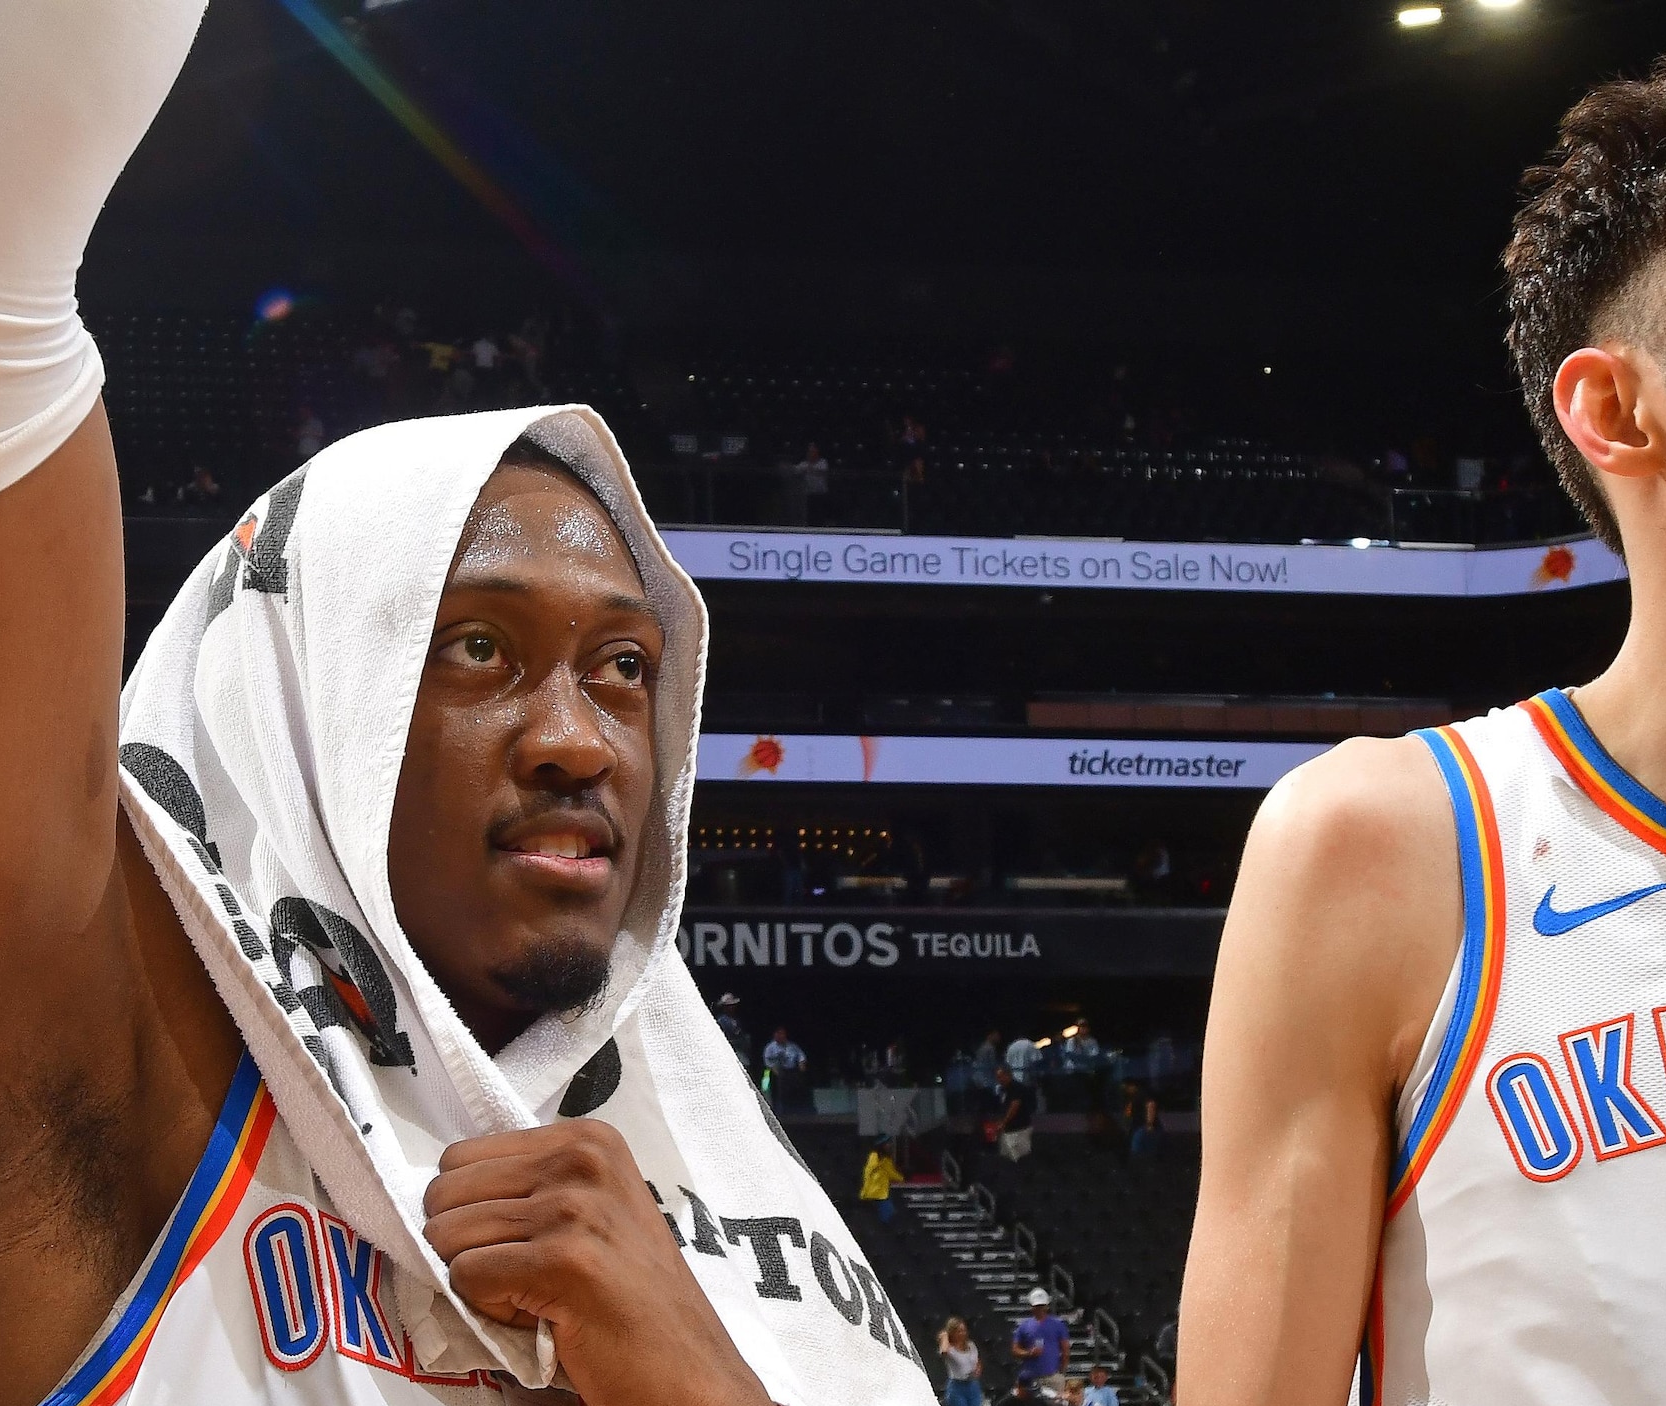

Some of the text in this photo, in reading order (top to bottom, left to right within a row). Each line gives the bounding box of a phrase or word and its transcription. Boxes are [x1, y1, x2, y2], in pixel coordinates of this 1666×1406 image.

[729, 541, 1289, 584] Single Game Tickets on Sale Now!
[1068, 748, 1247, 781] ticketmaster
[911, 932, 1041, 959] TEQUILA
